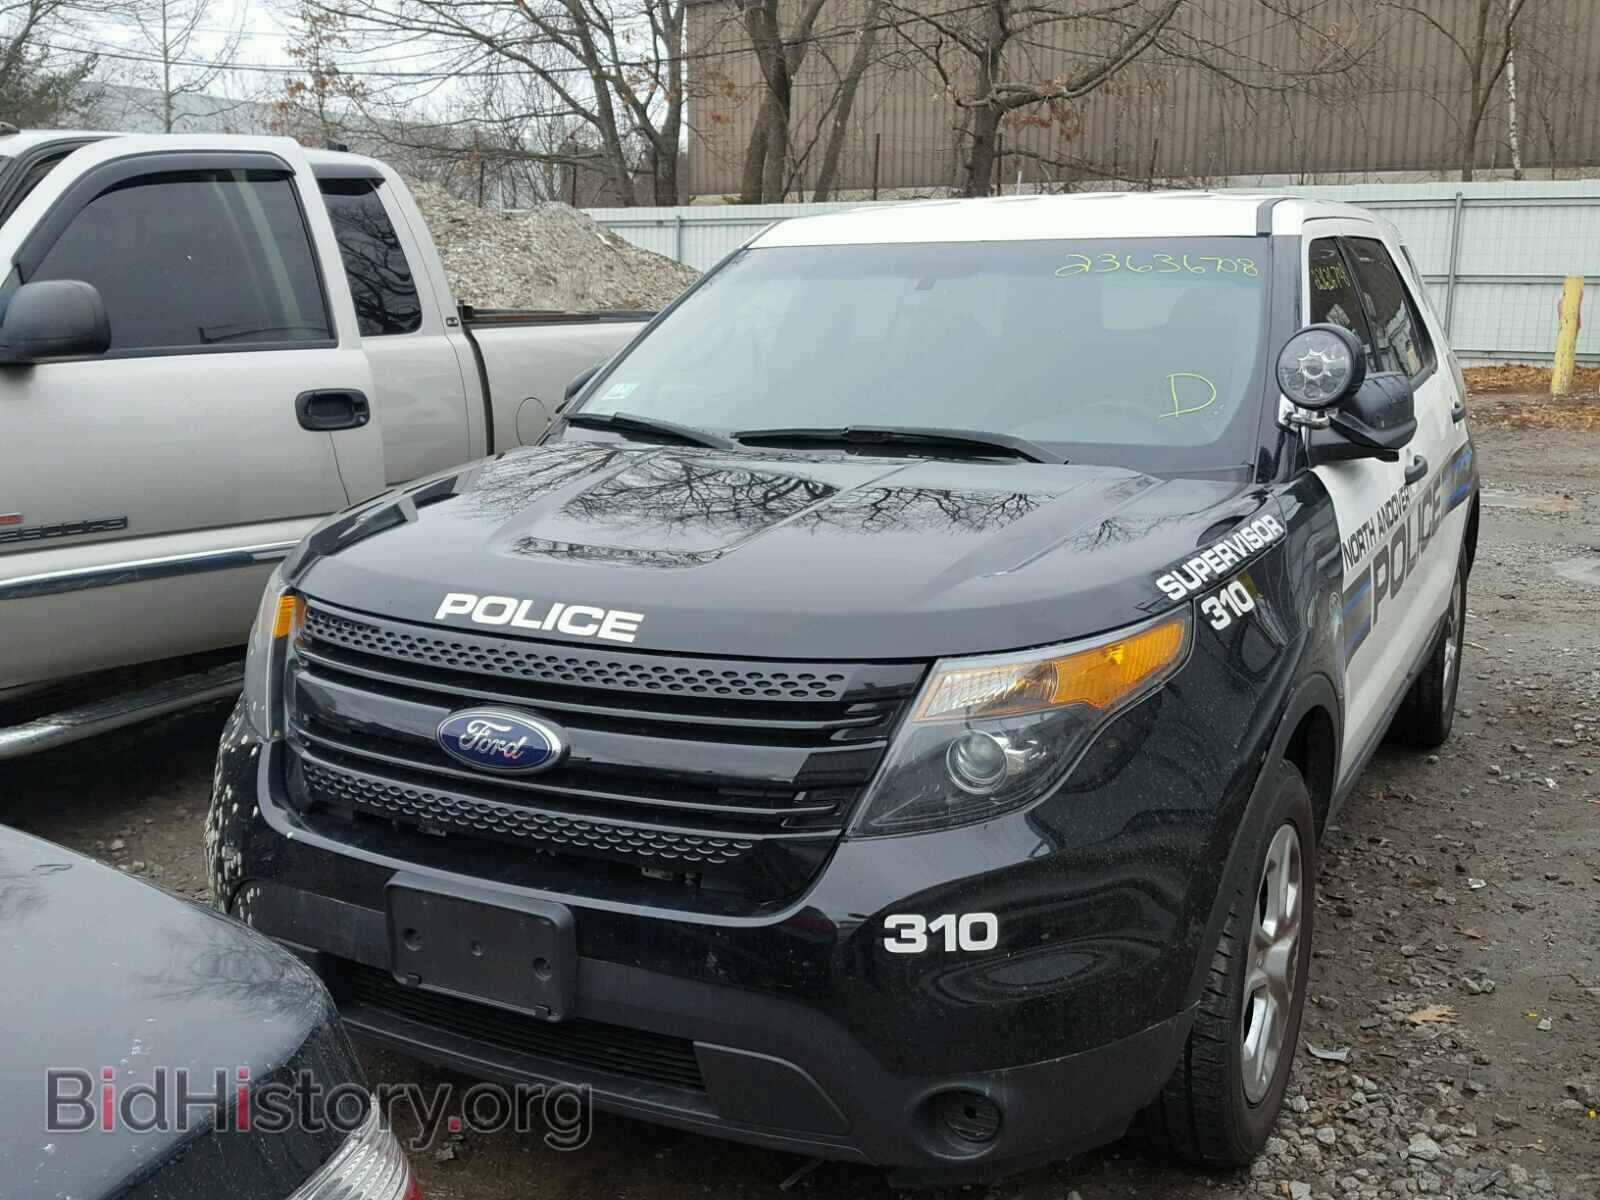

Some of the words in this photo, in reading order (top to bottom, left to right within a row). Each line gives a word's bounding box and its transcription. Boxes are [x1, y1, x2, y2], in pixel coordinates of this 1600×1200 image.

[1054, 253, 1259, 278] 23636708
[1342, 516, 1377, 572] NORTH
[1376, 485, 1411, 538] ANDOVER
[1371, 480, 1443, 626] POLICE
[1156, 514, 1285, 601] SUPERVISOR
[434, 592, 645, 643] POLICE
[1200, 579, 1255, 631] 310
[458, 719, 528, 760] Ford
[883, 912, 998, 953] 310
